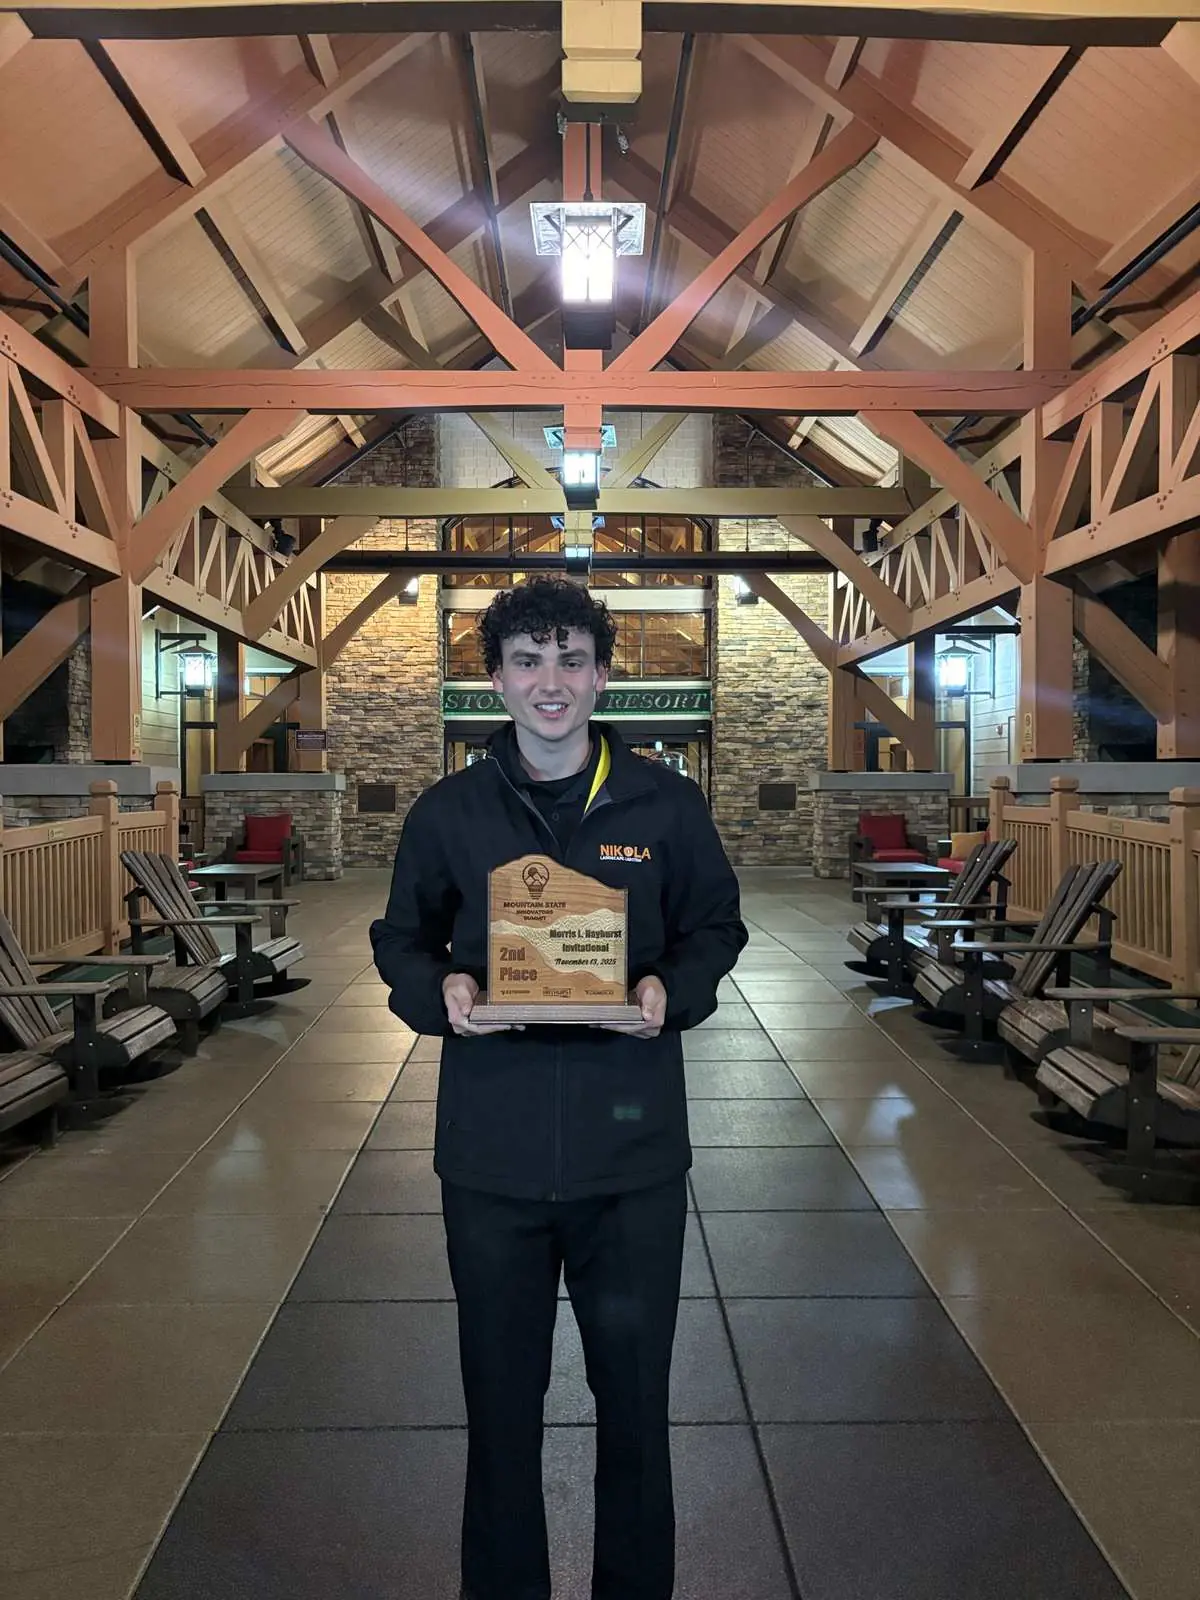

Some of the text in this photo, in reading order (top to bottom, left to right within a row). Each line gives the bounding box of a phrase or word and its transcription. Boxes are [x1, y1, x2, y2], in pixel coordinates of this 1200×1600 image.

[607, 692, 708, 709] RESORT
[600, 844, 651, 860] NIKOLA
[549, 929, 576, 938] Morris
[585, 929, 622, 939] Hayhurst
[499, 947, 526, 961] 2nd
[562, 943, 609, 952] Invitational
[600, 958, 617, 966] 2025
[499, 966, 538, 981] Place
